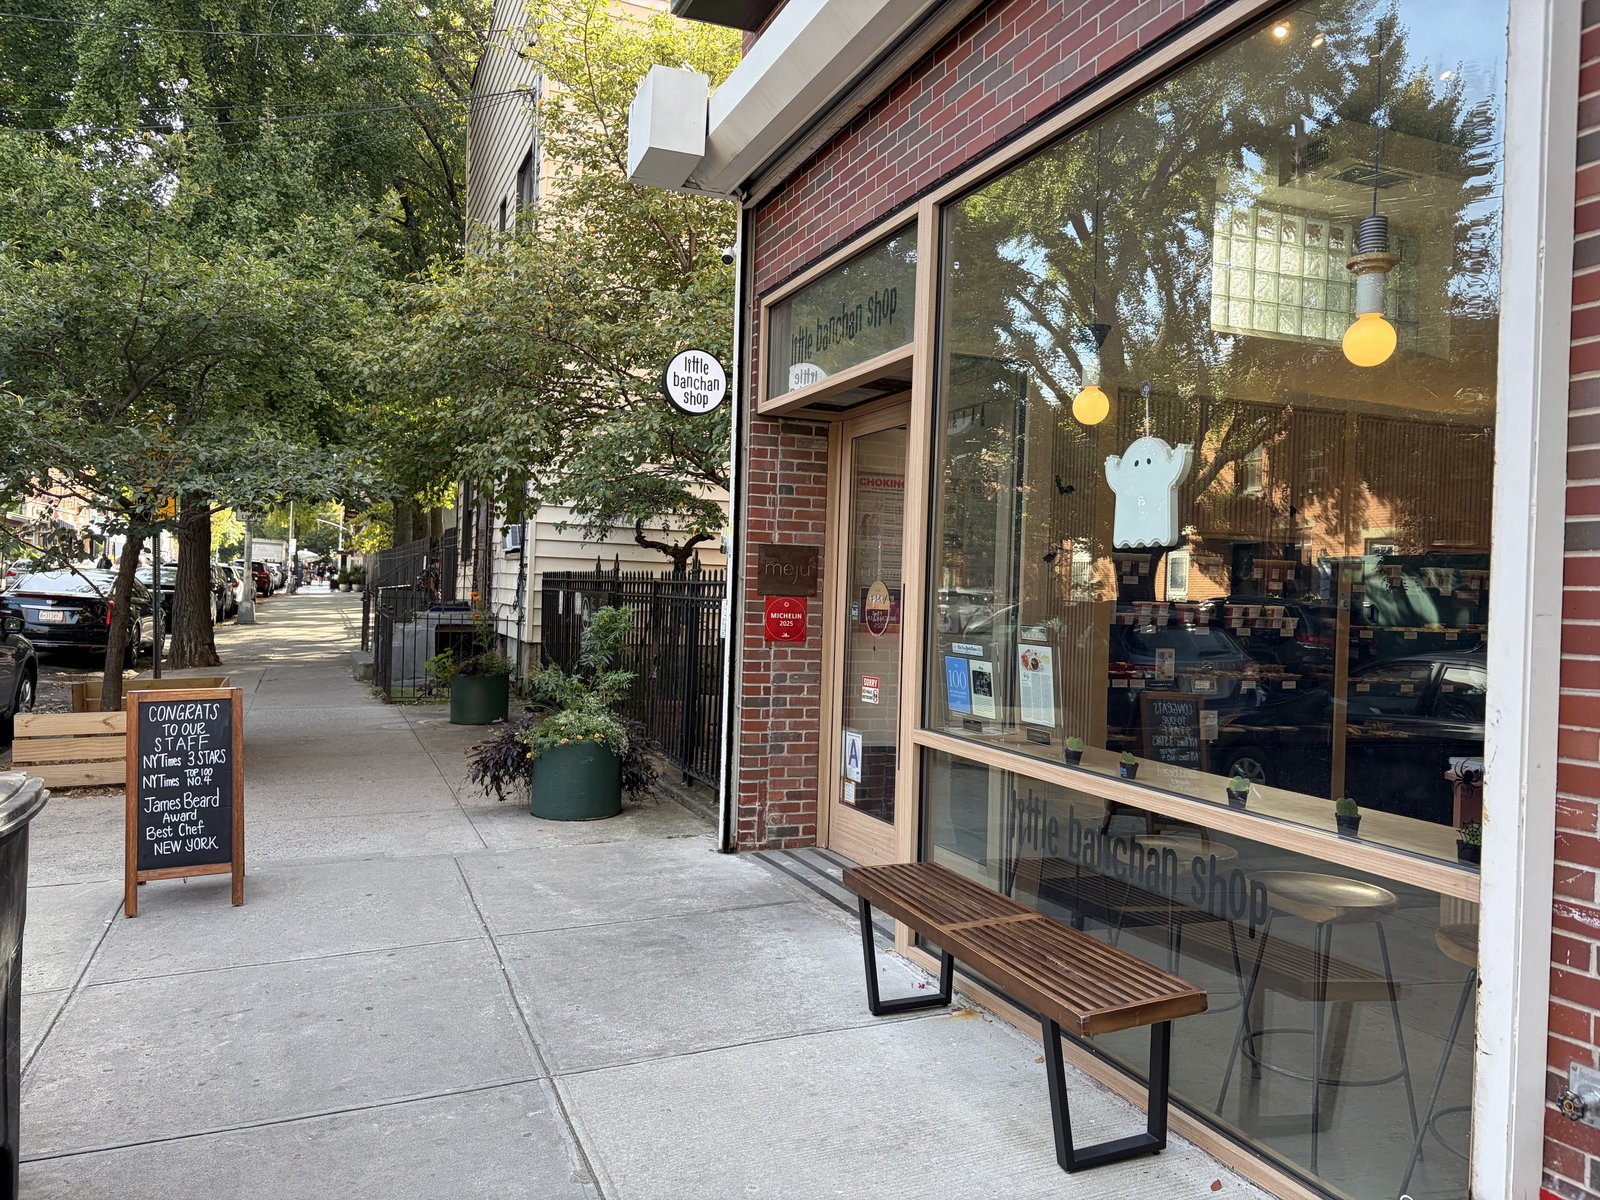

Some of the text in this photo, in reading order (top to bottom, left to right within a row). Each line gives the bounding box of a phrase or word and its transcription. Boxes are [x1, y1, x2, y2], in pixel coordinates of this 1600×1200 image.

[790, 287, 897, 366] little banchan shop
[684, 355, 710, 375] little
[673, 371, 720, 392] banchan
[683, 391, 709, 408] shop
[765, 562, 811, 585] meju
[770, 612, 802, 620] MICHELIN
[863, 678, 878, 688] SORRY
[948, 670, 967, 690] 100
[148, 703, 220, 722] CONGRATS
[162, 722, 206, 736] TO OUR
[154, 734, 210, 752] STAFF
[848, 738, 859, 768] A
[187, 752, 195, 766] 3
[197, 749, 226, 765] STARS
[184, 768, 214, 778] TOP 100
[144, 787, 220, 814] James Beard
[162, 809, 198, 824] Award
[146, 820, 204, 841] Best Chef
[154, 836, 219, 856] NEW YORK
[1011, 788, 1269, 940] little banchan shop
